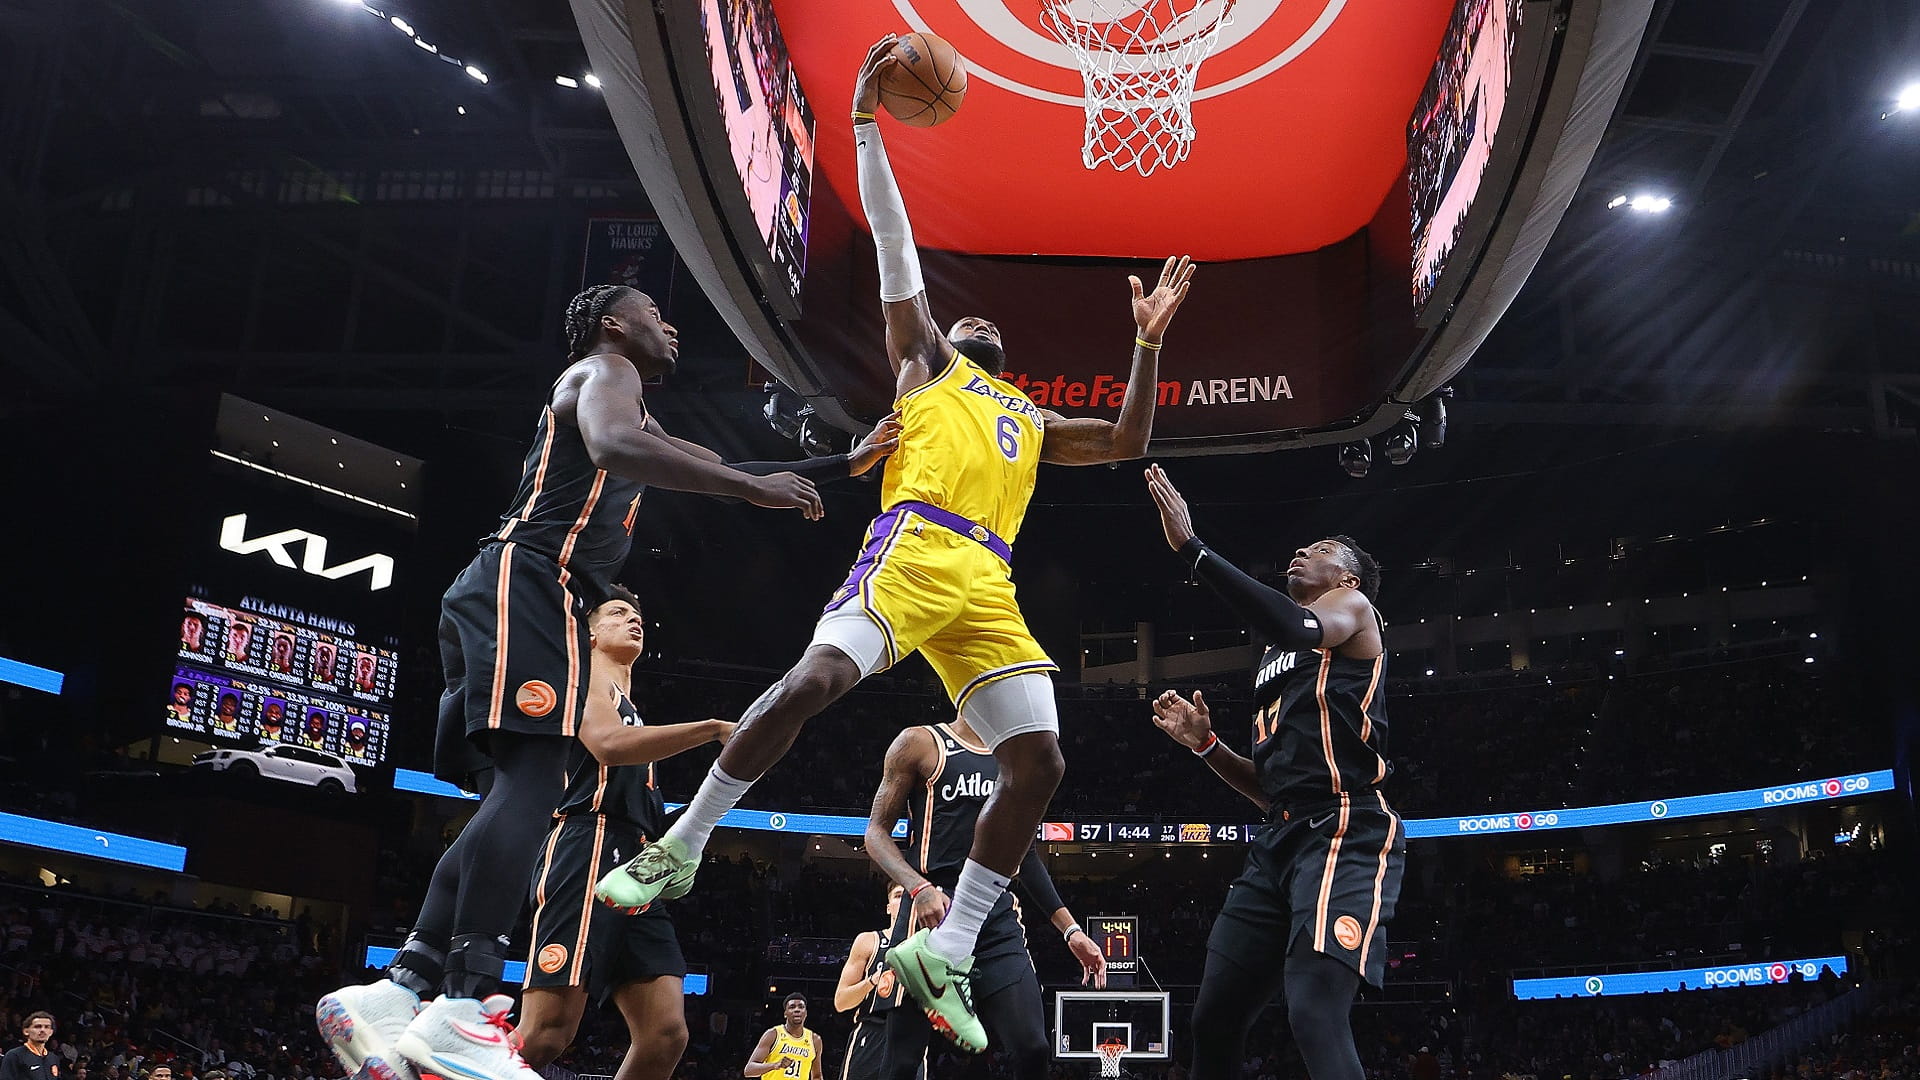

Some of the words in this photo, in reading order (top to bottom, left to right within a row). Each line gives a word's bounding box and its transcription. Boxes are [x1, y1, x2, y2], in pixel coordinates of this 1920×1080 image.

[608, 223, 623, 237] ST.
[627, 223, 659, 237] LOUIS
[611, 237, 654, 249] HAWKS
[996, 371, 1181, 408] StateFam
[1187, 375, 1294, 406] ARENA
[961, 373, 1044, 432] LAKERS
[996, 415, 1022, 462] 6
[240, 595, 306, 624] ATLANTA
[307, 611, 356, 636] HAWKS
[369, 646, 376, 655] 3
[391, 652, 398, 661] 6
[324, 700, 347, 713] 100%
[361, 709, 368, 719] 2
[383, 714, 389, 723] 5
[942, 772, 995, 801] Atla
[1763, 786, 1818, 804] ROOMS
[1820, 778, 1842, 796] TO
[1843, 777, 1870, 792] GO
[1459, 817, 1511, 831] ROOMS
[1513, 813, 1533, 829] TO
[1534, 813, 1558, 826] GO
[1080, 824, 1101, 840] 57
[1118, 825, 1150, 839] 4:44
[1162, 825, 1173, 834] 17
[1160, 834, 1175, 842] 2ND
[1217, 826, 1238, 841] 45
[1102, 922, 1131, 934] 4:44
[1106, 935, 1128, 957] 17
[1705, 967, 1762, 985] ROOMS
[1765, 963, 1787, 980] TO
[779, 1043, 809, 1058] LAKERS
